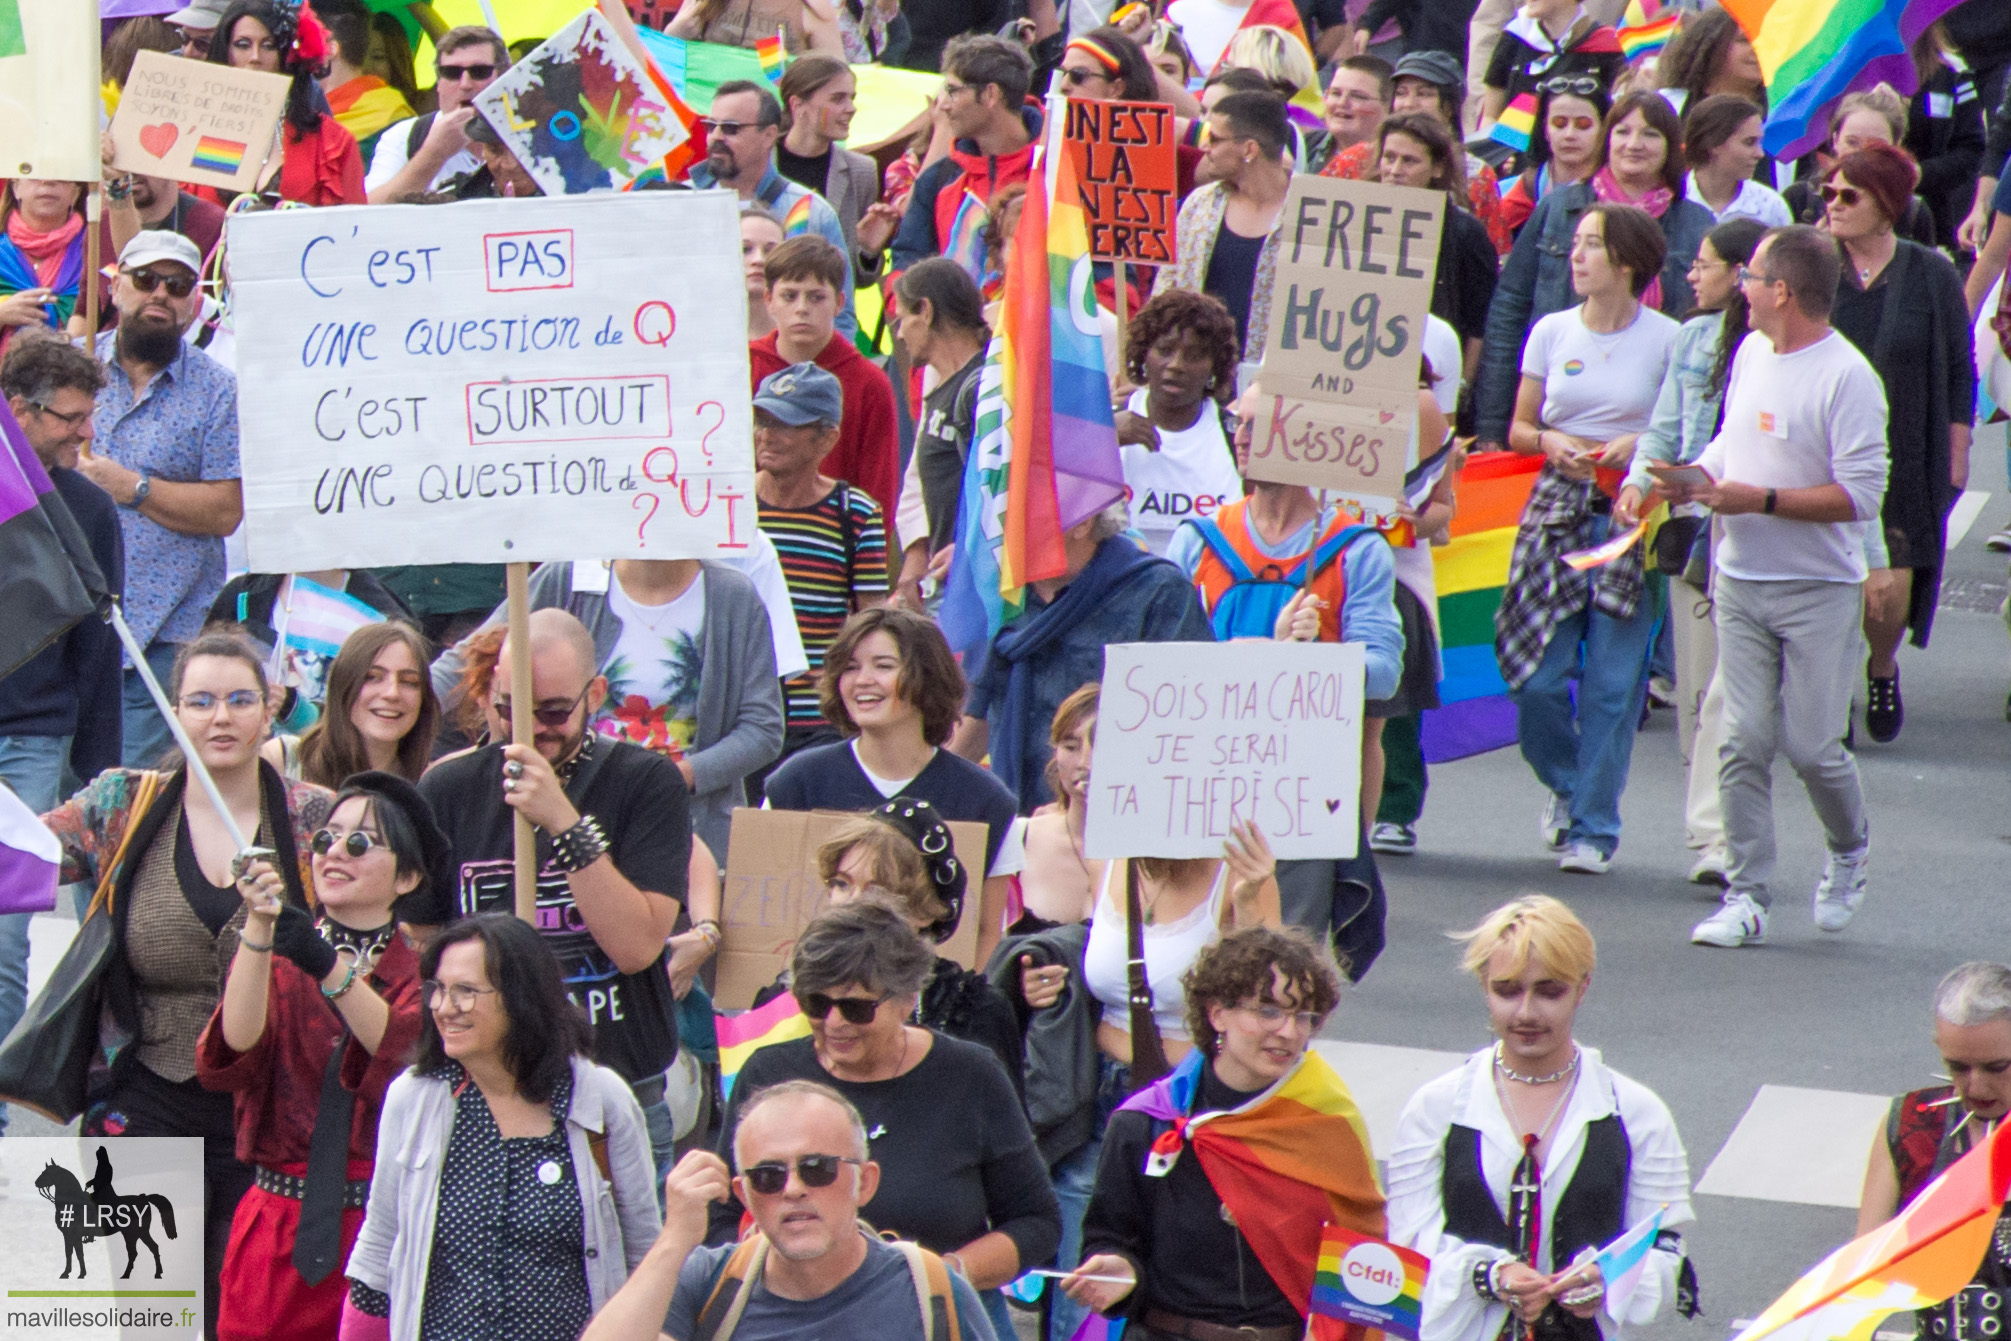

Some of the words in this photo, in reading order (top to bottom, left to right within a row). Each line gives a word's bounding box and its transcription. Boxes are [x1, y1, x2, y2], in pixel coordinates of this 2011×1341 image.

[138, 69, 188, 90] NOUS
[201, 80, 273, 106] SOMMES
[193, 95, 211, 110] DE
[129, 99, 189, 123] SOYONS
[501, 86, 667, 166] LOVE
[1108, 105, 1169, 146] EST
[1086, 142, 1133, 185] LA
[1113, 186, 1172, 225] EST
[1291, 195, 1433, 279] FREE
[498, 240, 567, 278] PAS
[593, 314, 624, 347] de
[633, 300, 677, 348] Q
[1279, 283, 1410, 371] Hugs
[1310, 372, 1354, 395] AND
[474, 383, 655, 437] SURTOUT
[1253, 394, 1384, 477] Kisses
[618, 464, 639, 491] de
[1221, 680, 1257, 721] MA
[1267, 670, 1351, 727] CAROL,
[1147, 733, 1195, 765] JE
[1106, 784, 1139, 816] TA
